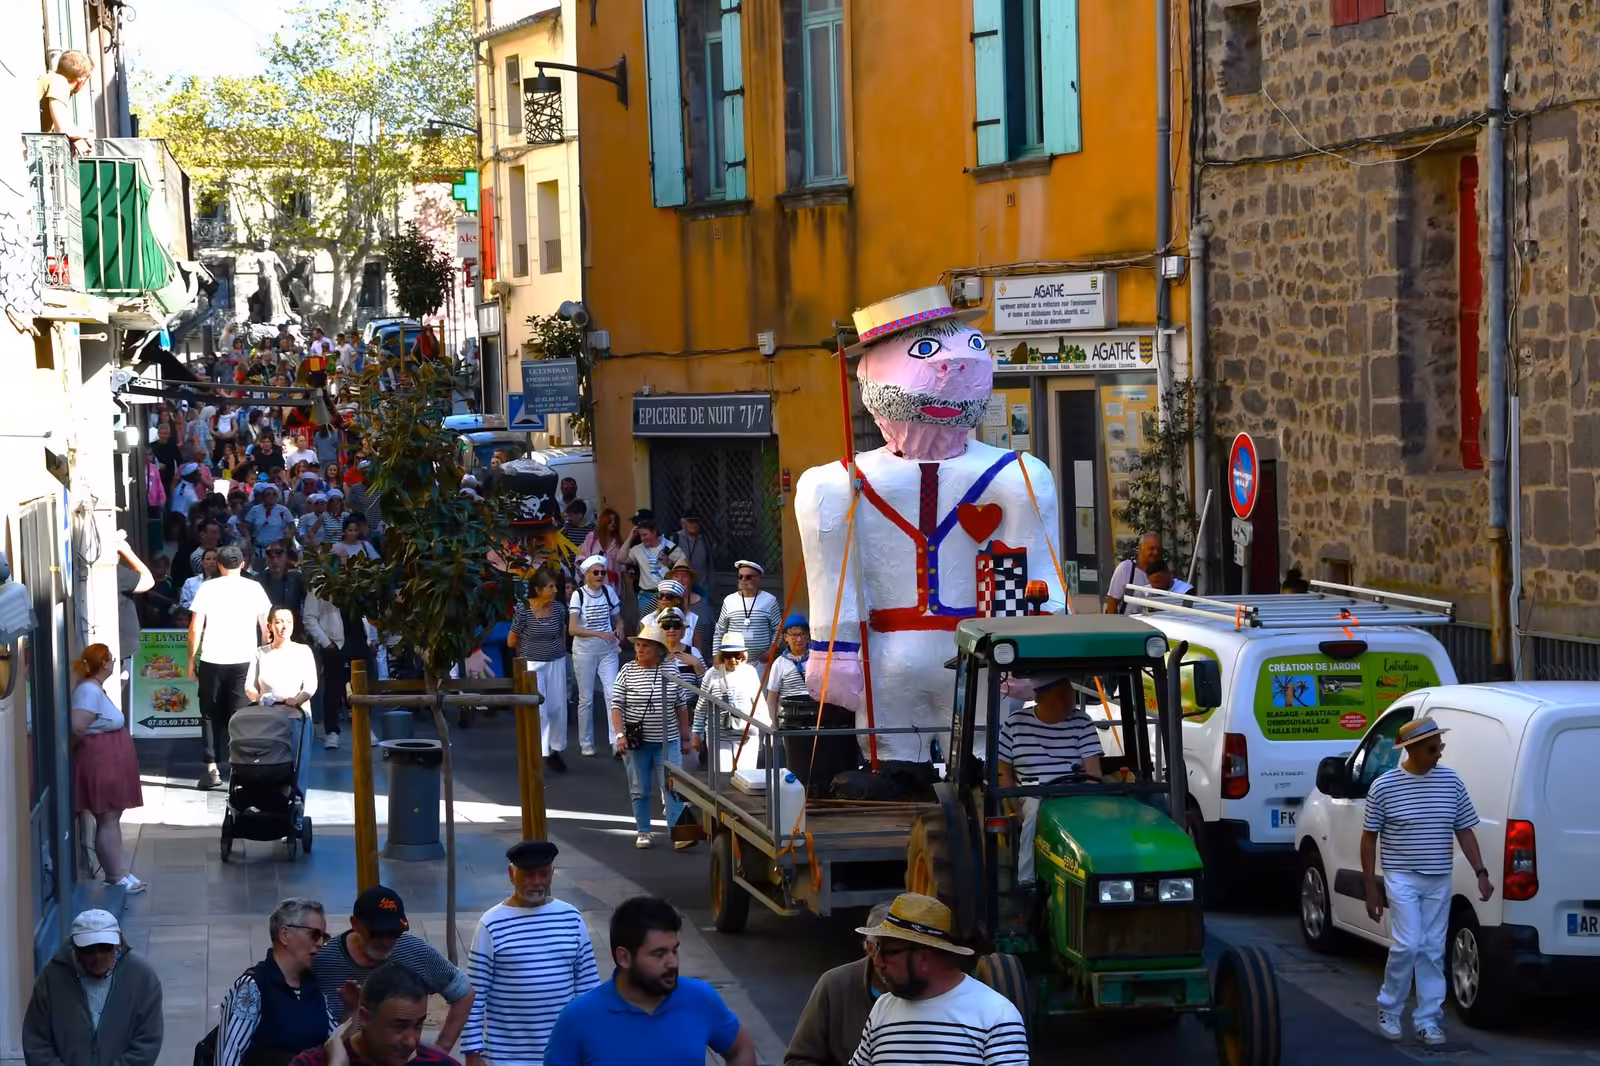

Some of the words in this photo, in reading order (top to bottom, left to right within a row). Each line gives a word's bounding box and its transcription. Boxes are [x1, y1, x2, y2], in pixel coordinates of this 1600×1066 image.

[1034, 284, 1064, 298] AGATHE
[1092, 342, 1136, 361] AGATHE
[639, 406, 687, 425] EPICERIE
[690, 406, 704, 424] DE
[708, 406, 734, 424] NUIT
[740, 404, 764, 429] 7J/7
[1268, 662, 1313, 672] CRÉATION
[1315, 663, 1327, 671] DE
[1330, 662, 1360, 671] JARDIN
[1280, 812, 1296, 824] FK
[1580, 916, 1598, 932] AR
